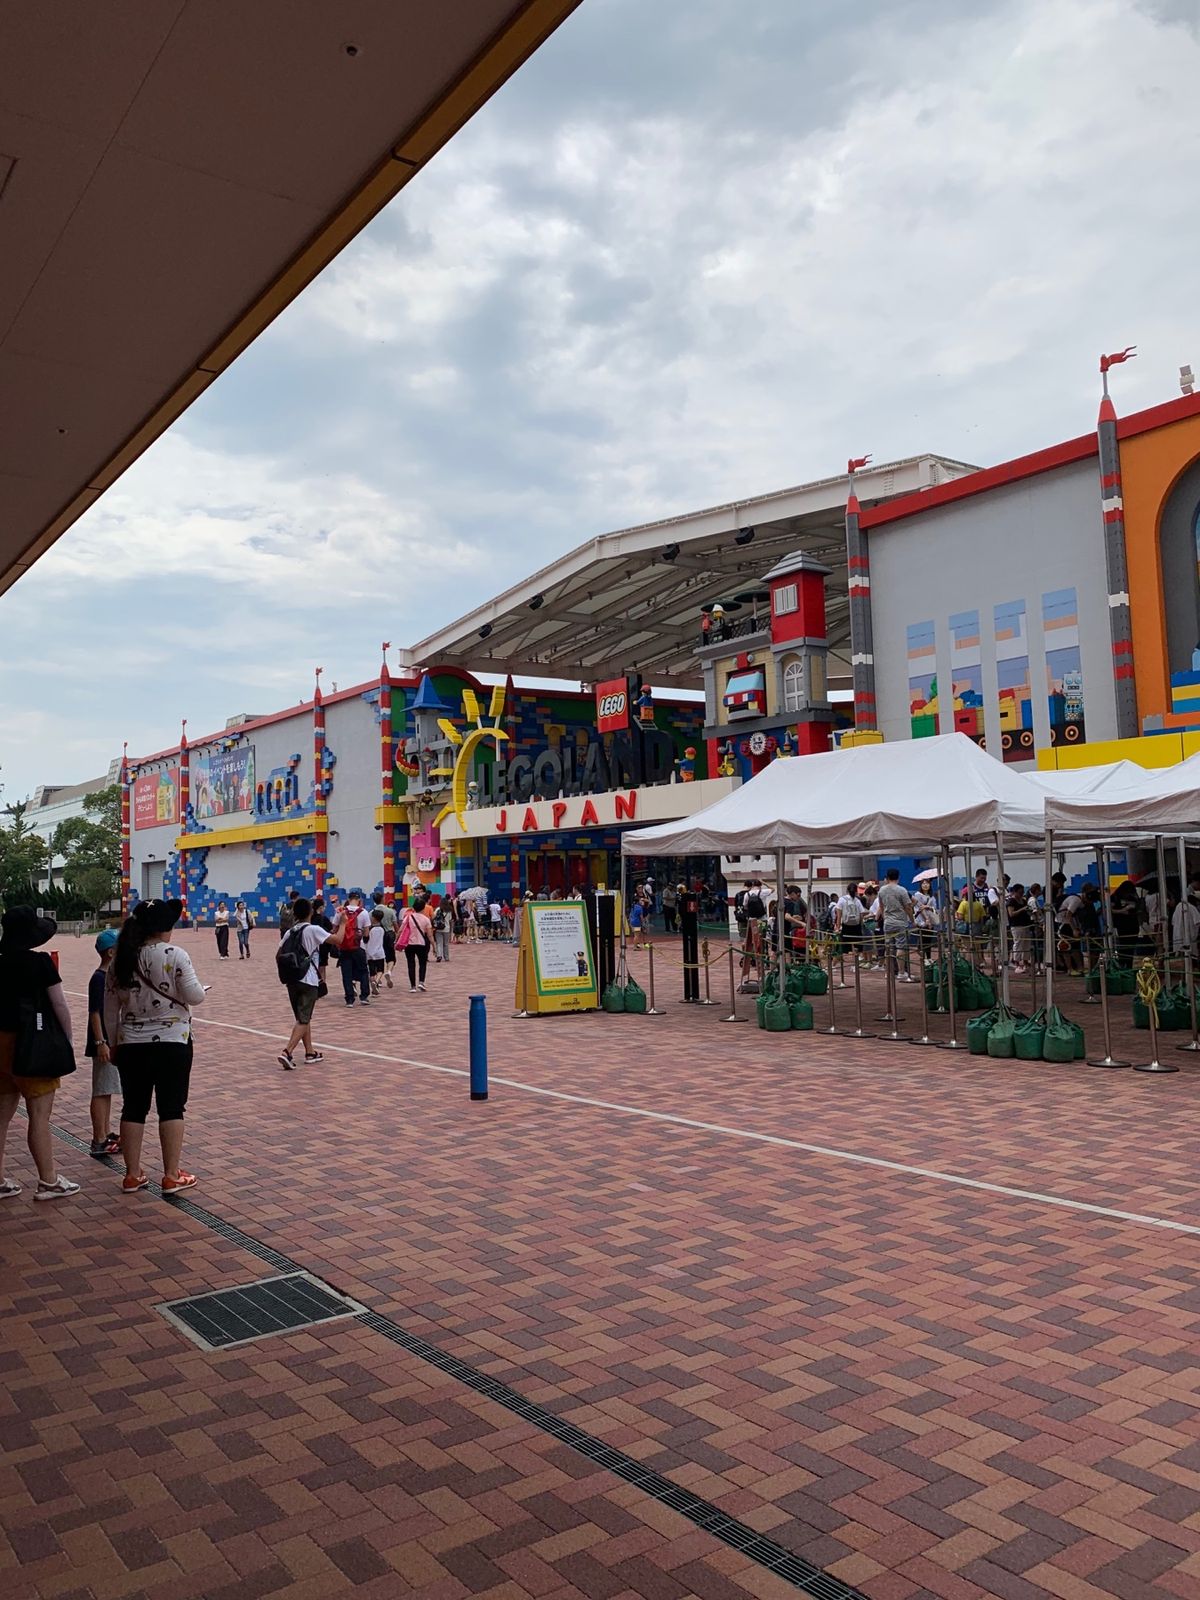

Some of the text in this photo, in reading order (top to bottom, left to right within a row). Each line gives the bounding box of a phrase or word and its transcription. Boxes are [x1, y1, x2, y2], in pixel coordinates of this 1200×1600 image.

[599, 693, 626, 717] LEGO
[478, 730, 676, 805] LEGOLAND
[496, 790, 637, 832] JAPAN
